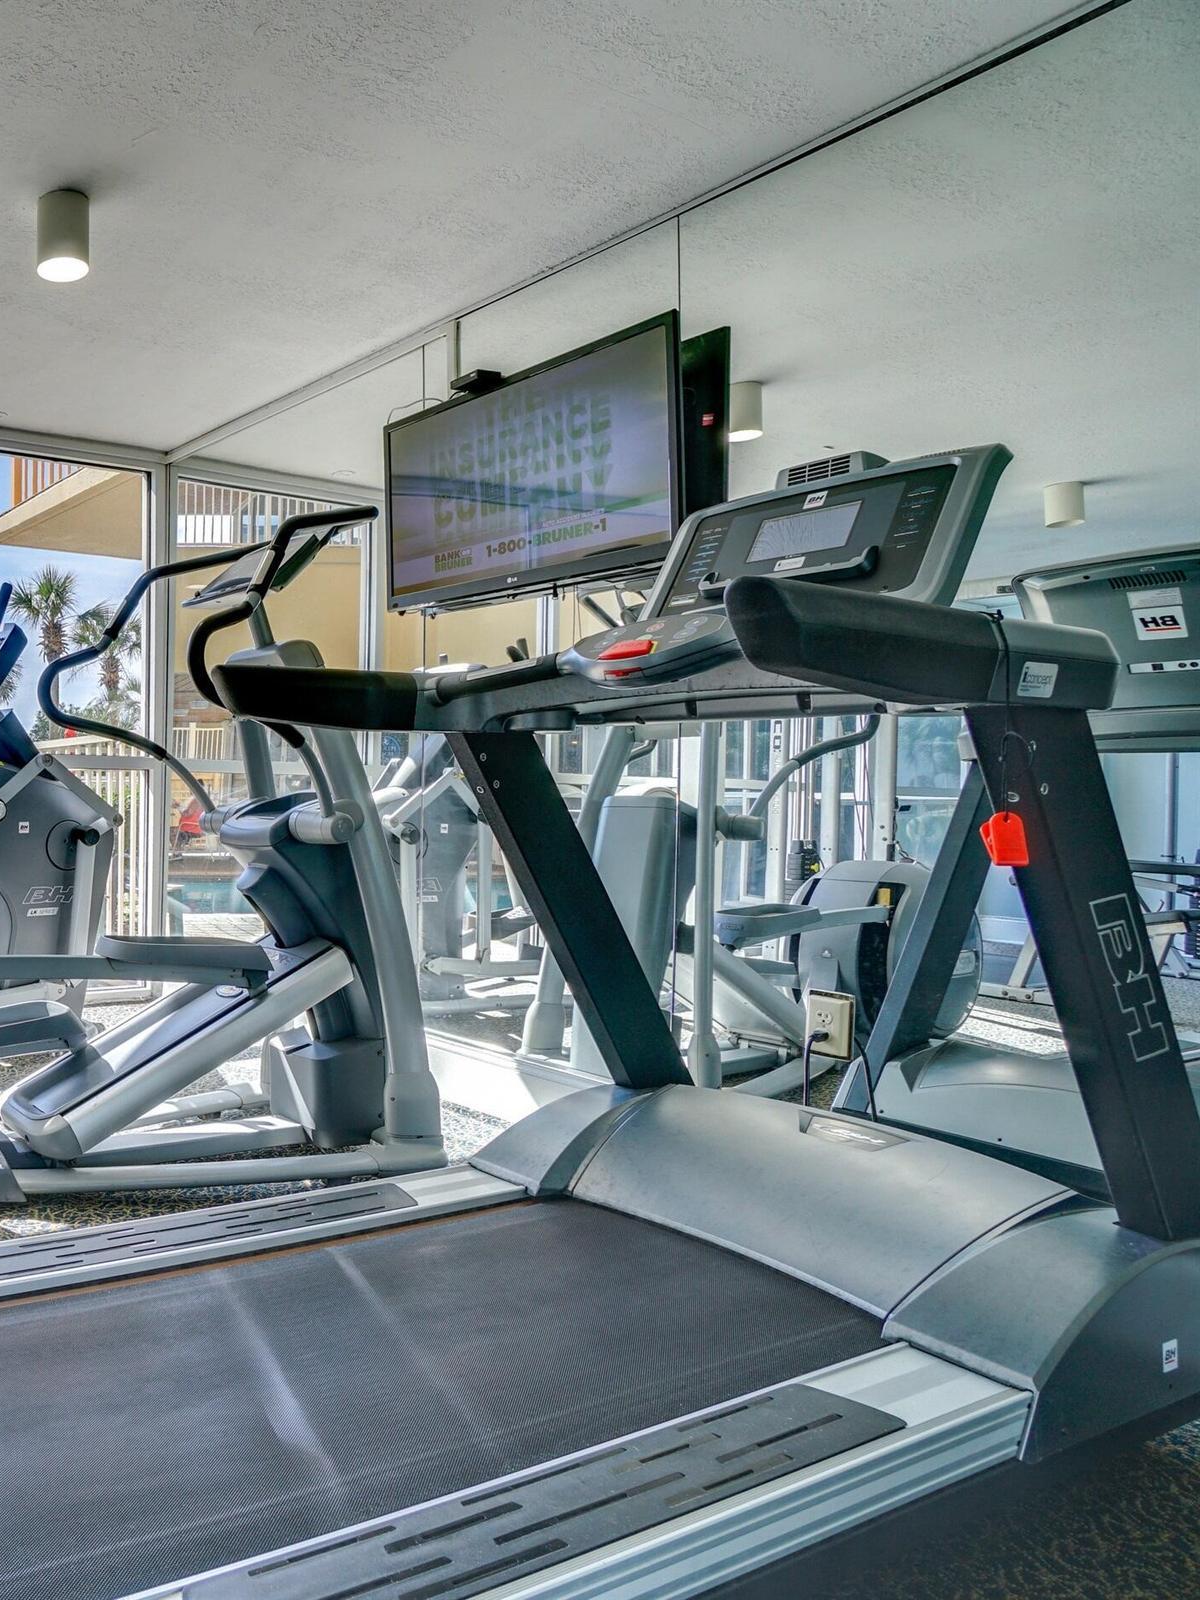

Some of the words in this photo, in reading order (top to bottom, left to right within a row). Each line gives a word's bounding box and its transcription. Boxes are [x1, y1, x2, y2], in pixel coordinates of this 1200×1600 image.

[434, 550, 461, 563] BANK
[434, 557, 472, 573] BRUNER
[22, 886, 75, 904] BH
[1089, 893, 1170, 1062] BH
[1165, 1347, 1176, 1361] BH
